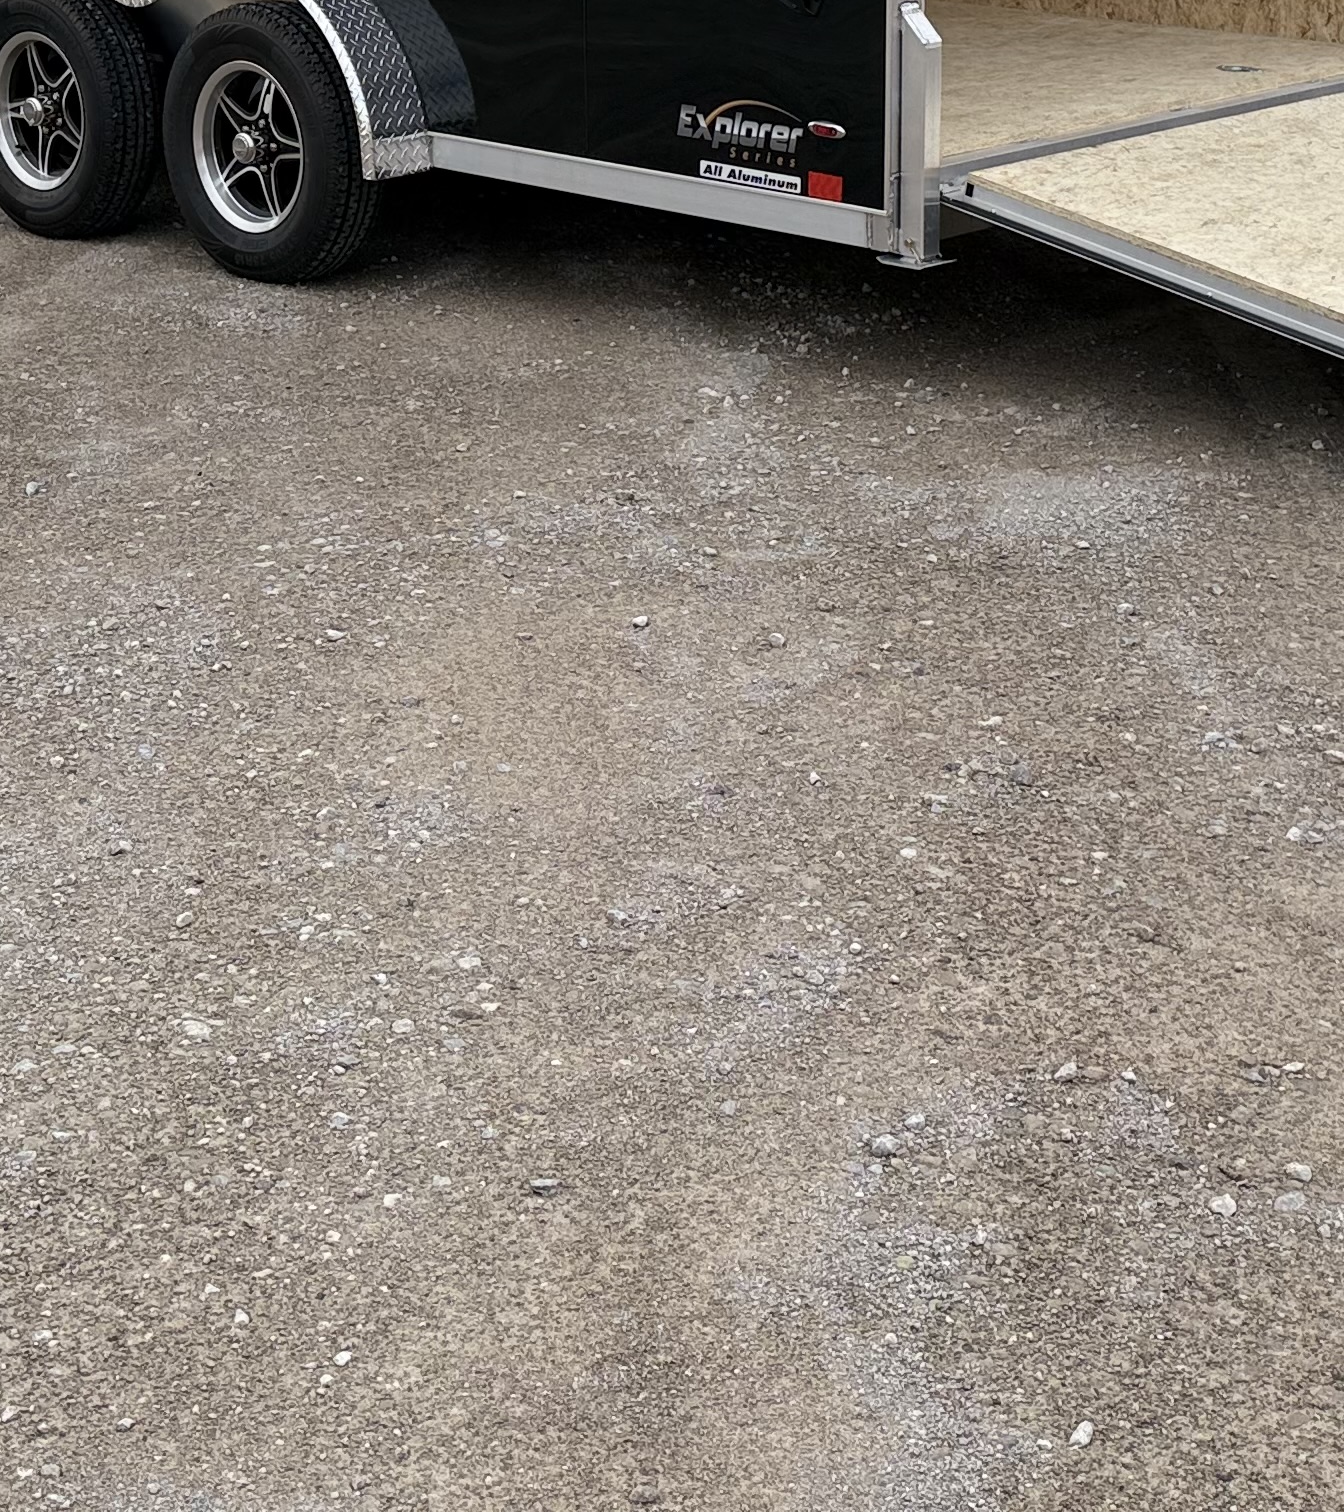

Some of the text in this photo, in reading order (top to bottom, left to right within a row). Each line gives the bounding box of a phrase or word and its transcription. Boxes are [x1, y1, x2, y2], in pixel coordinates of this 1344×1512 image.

[677, 104, 803, 153] Explorer
[729, 146, 796, 168] Series
[703, 164, 798, 190] All Aluminum
